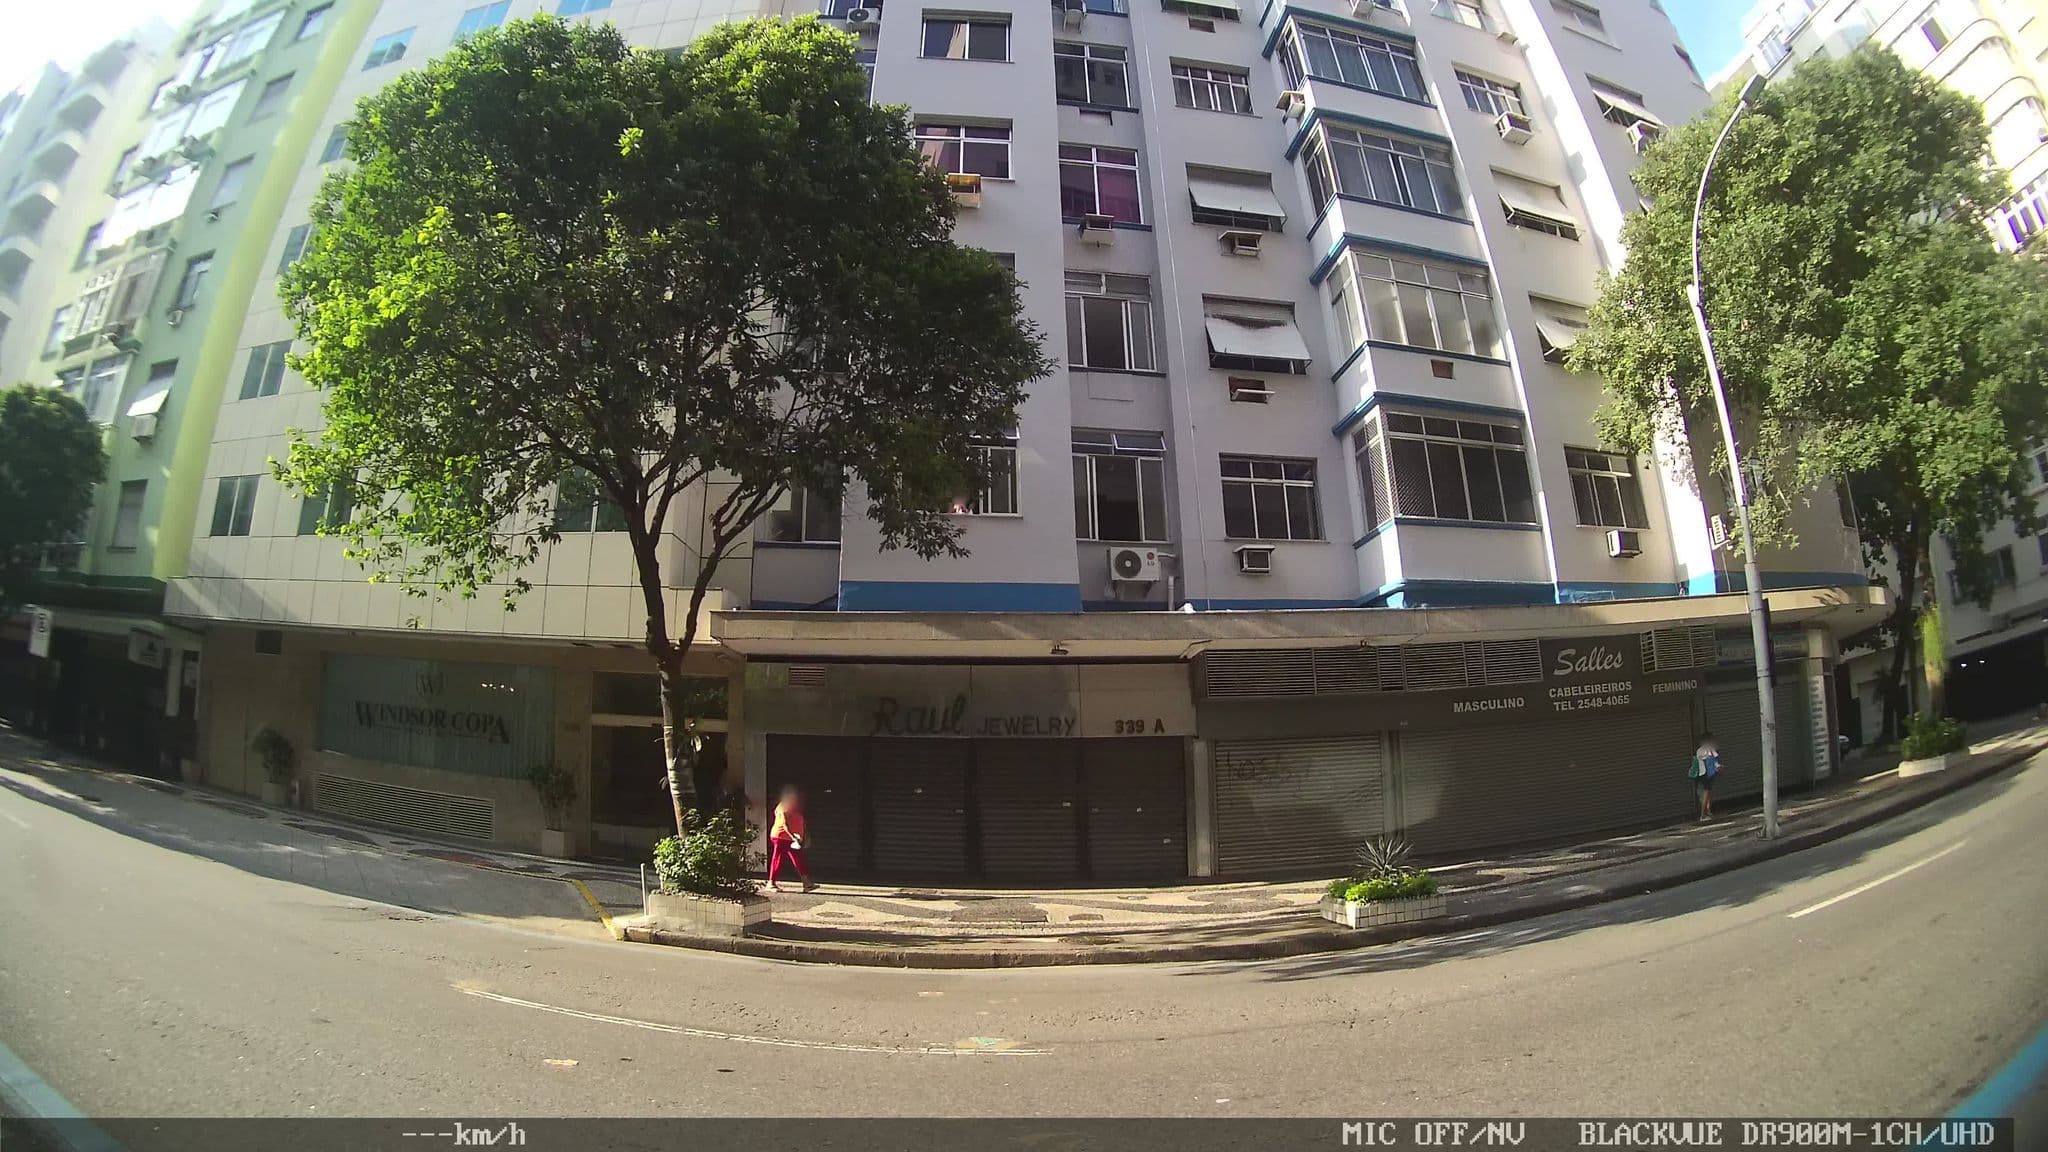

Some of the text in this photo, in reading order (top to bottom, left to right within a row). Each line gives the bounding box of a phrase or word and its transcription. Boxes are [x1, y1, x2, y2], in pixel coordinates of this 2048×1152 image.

[1553, 645, 1625, 677] Salles
[1549, 681, 1632, 698] CABELEIREIROS
[1652, 679, 1699, 694] FEMININO
[1453, 697, 1526, 714] MASCULINO
[1553, 696, 1631, 712] TEL 2548-4065
[354, 700, 510, 745] WINDSOR COPA
[872, 696, 1077, 737] Raul JEWELRY
[1114, 718, 1166, 734] 339 A
